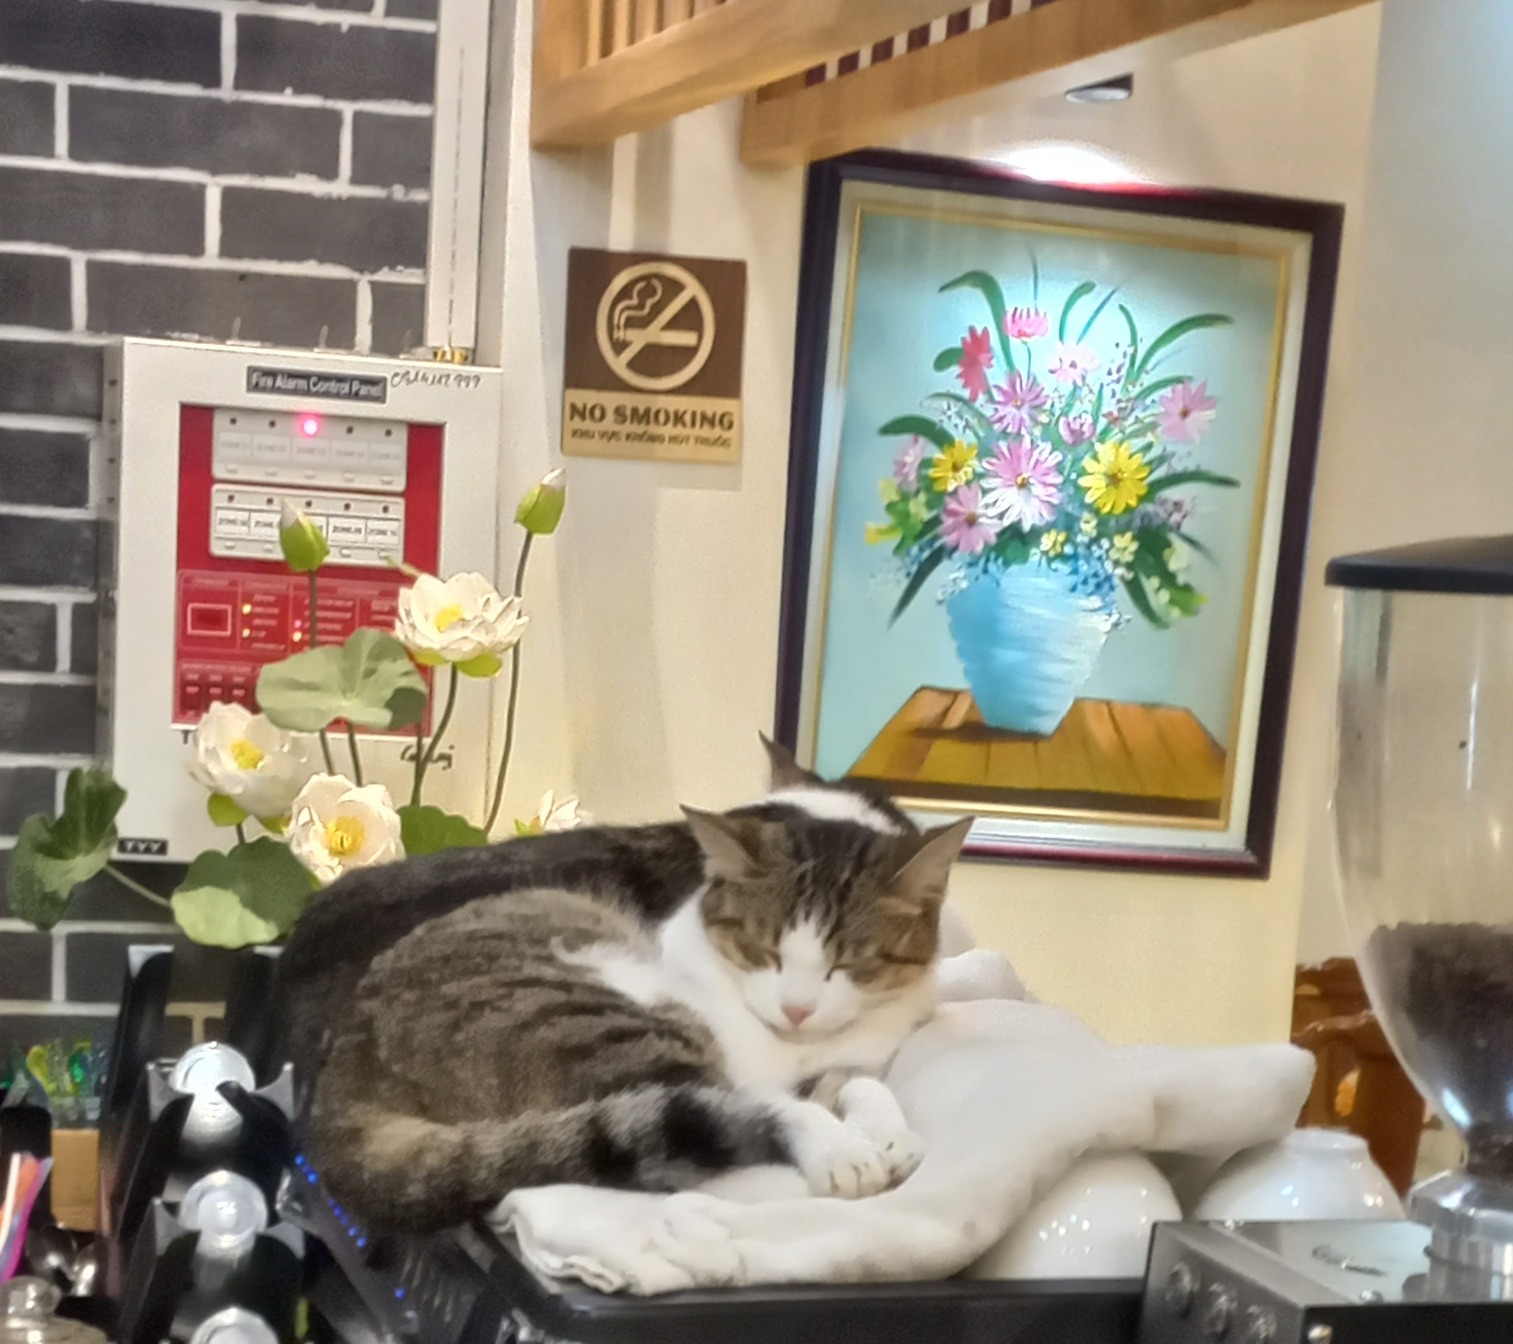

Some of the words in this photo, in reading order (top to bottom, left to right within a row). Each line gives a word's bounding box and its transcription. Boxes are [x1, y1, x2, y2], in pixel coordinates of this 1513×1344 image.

[252, 371, 274, 389] Fire
[275, 374, 308, 391] Alarm
[309, 376, 350, 395] Control
[351, 380, 383, 397] Panel
[569, 402, 607, 424] NO
[613, 404, 734, 431] SMOKING
